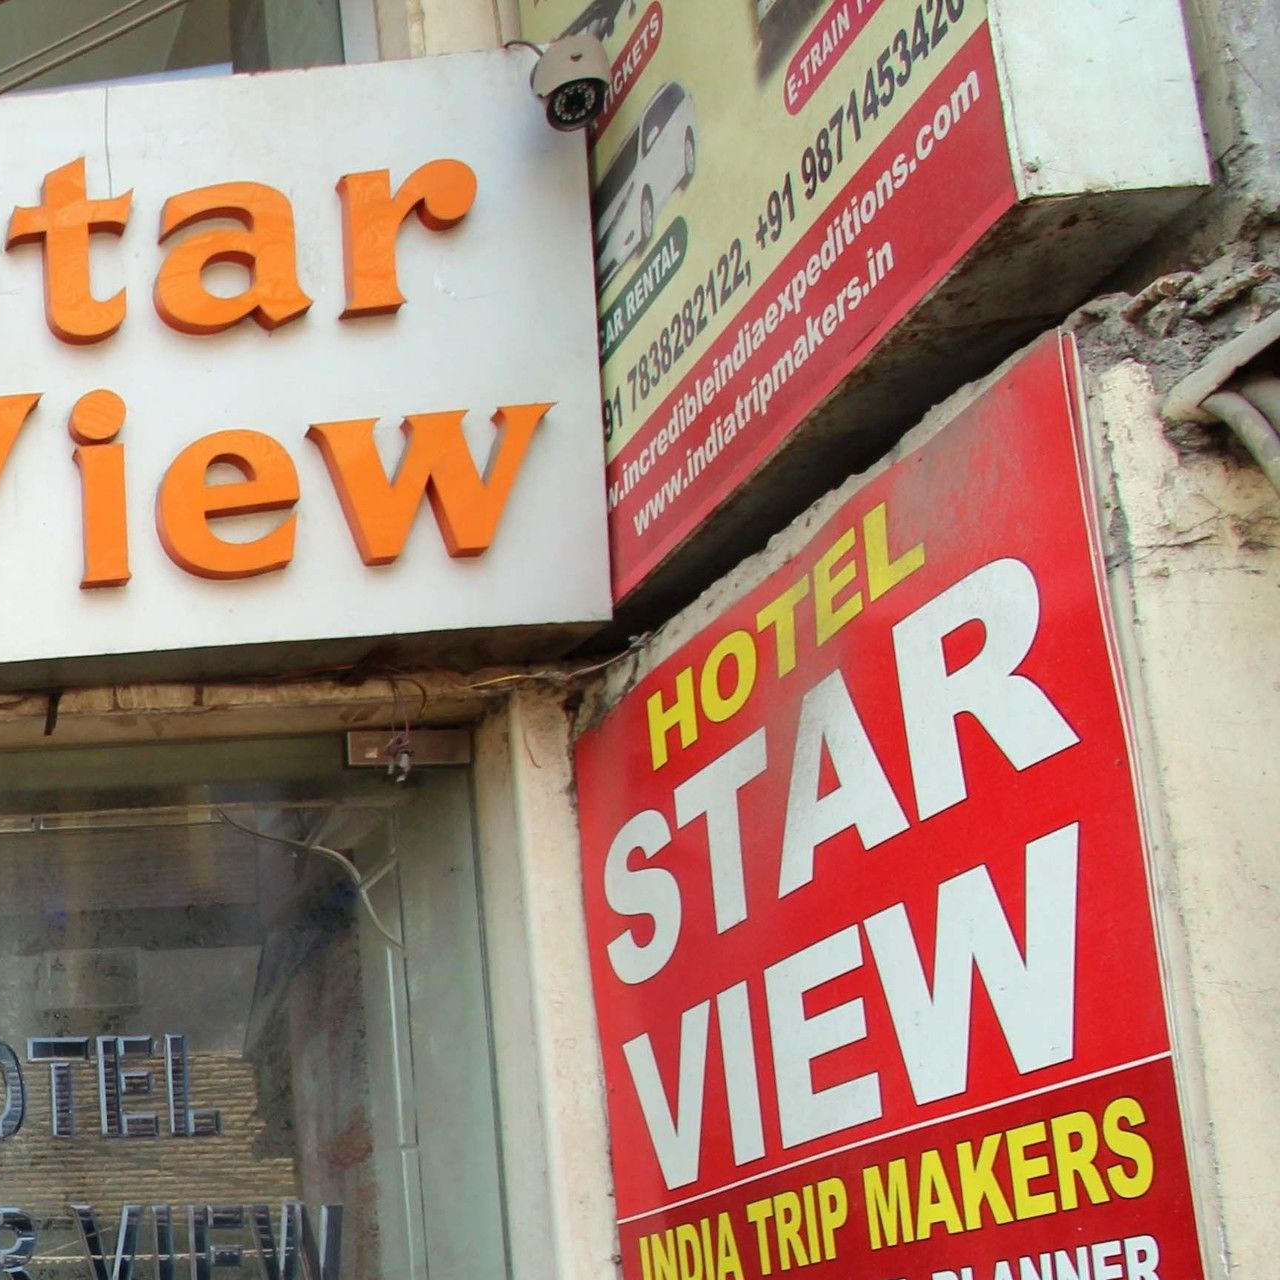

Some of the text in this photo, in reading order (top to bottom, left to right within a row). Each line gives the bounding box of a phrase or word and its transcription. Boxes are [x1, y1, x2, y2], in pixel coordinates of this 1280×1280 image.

[600, 242, 680, 355] AR RENTAL
[755, 171, 795, 250] +91
[633, 241, 894, 536] www.indiatripmakers.in
[648, 502, 925, 770] HOTEL
[604, 557, 1080, 985] STAR
[622, 822, 1079, 1191] VIEW
[746, 1177, 848, 1276] TRIP
[862, 1097, 1154, 1250] MAKERS
